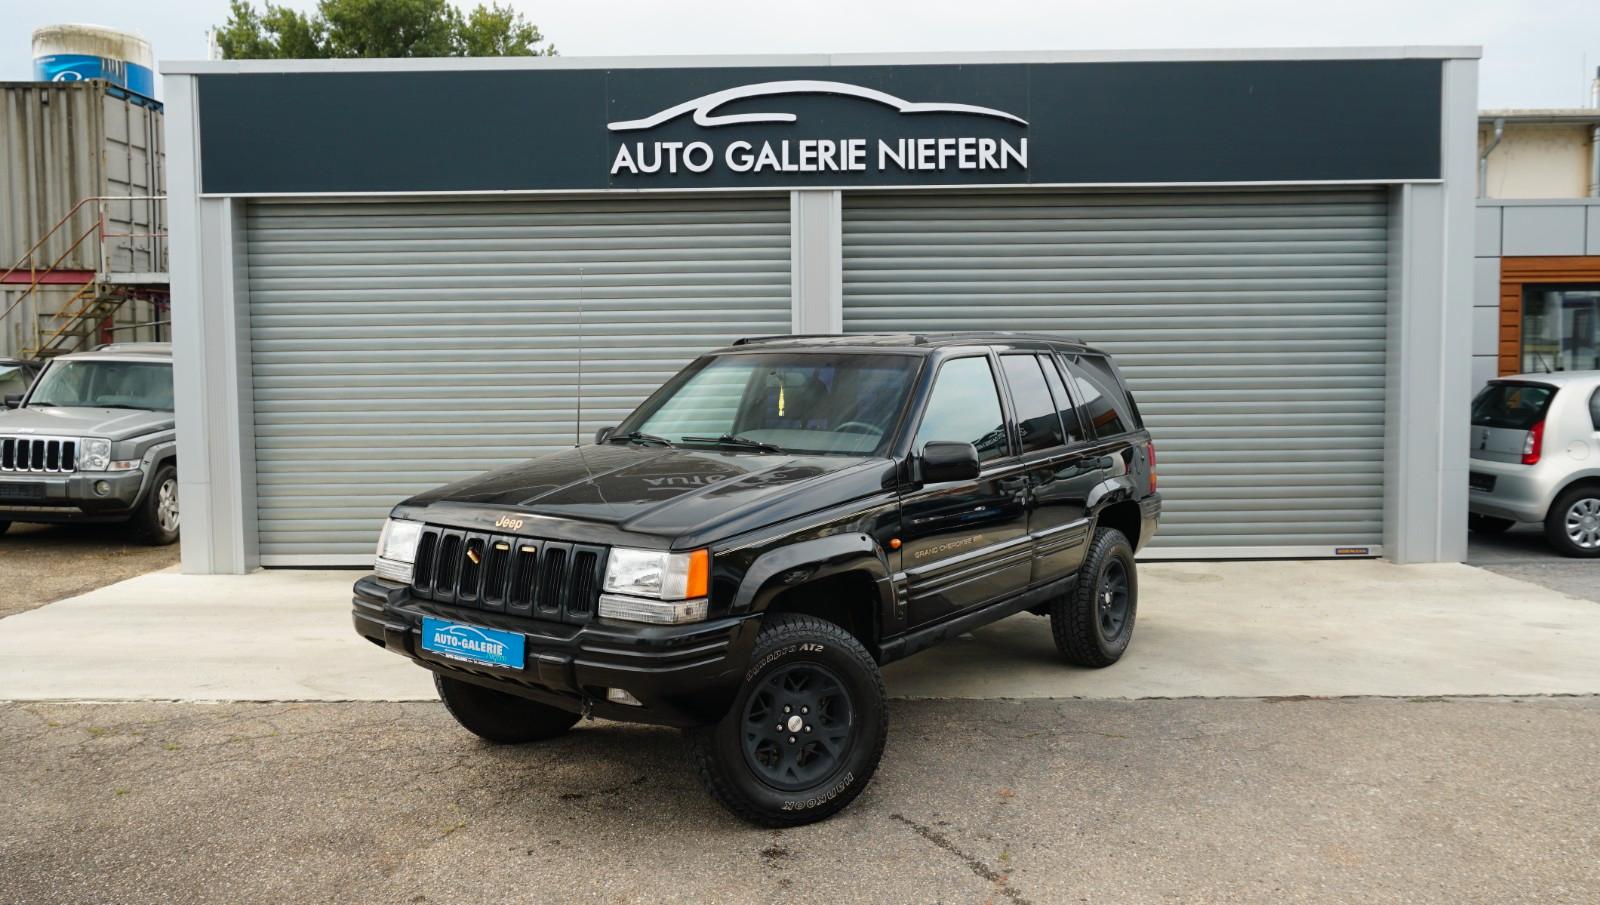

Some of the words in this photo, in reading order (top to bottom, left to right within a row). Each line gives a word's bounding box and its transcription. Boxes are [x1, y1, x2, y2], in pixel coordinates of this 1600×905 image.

[611, 141, 714, 175] AUTO
[725, 139, 867, 173] GALERIE
[878, 137, 1028, 171] NIEFERN
[495, 515, 523, 531] Jeep
[433, 632, 503, 656] AUTO-GALERIE
[799, 642, 824, 652] AT2
